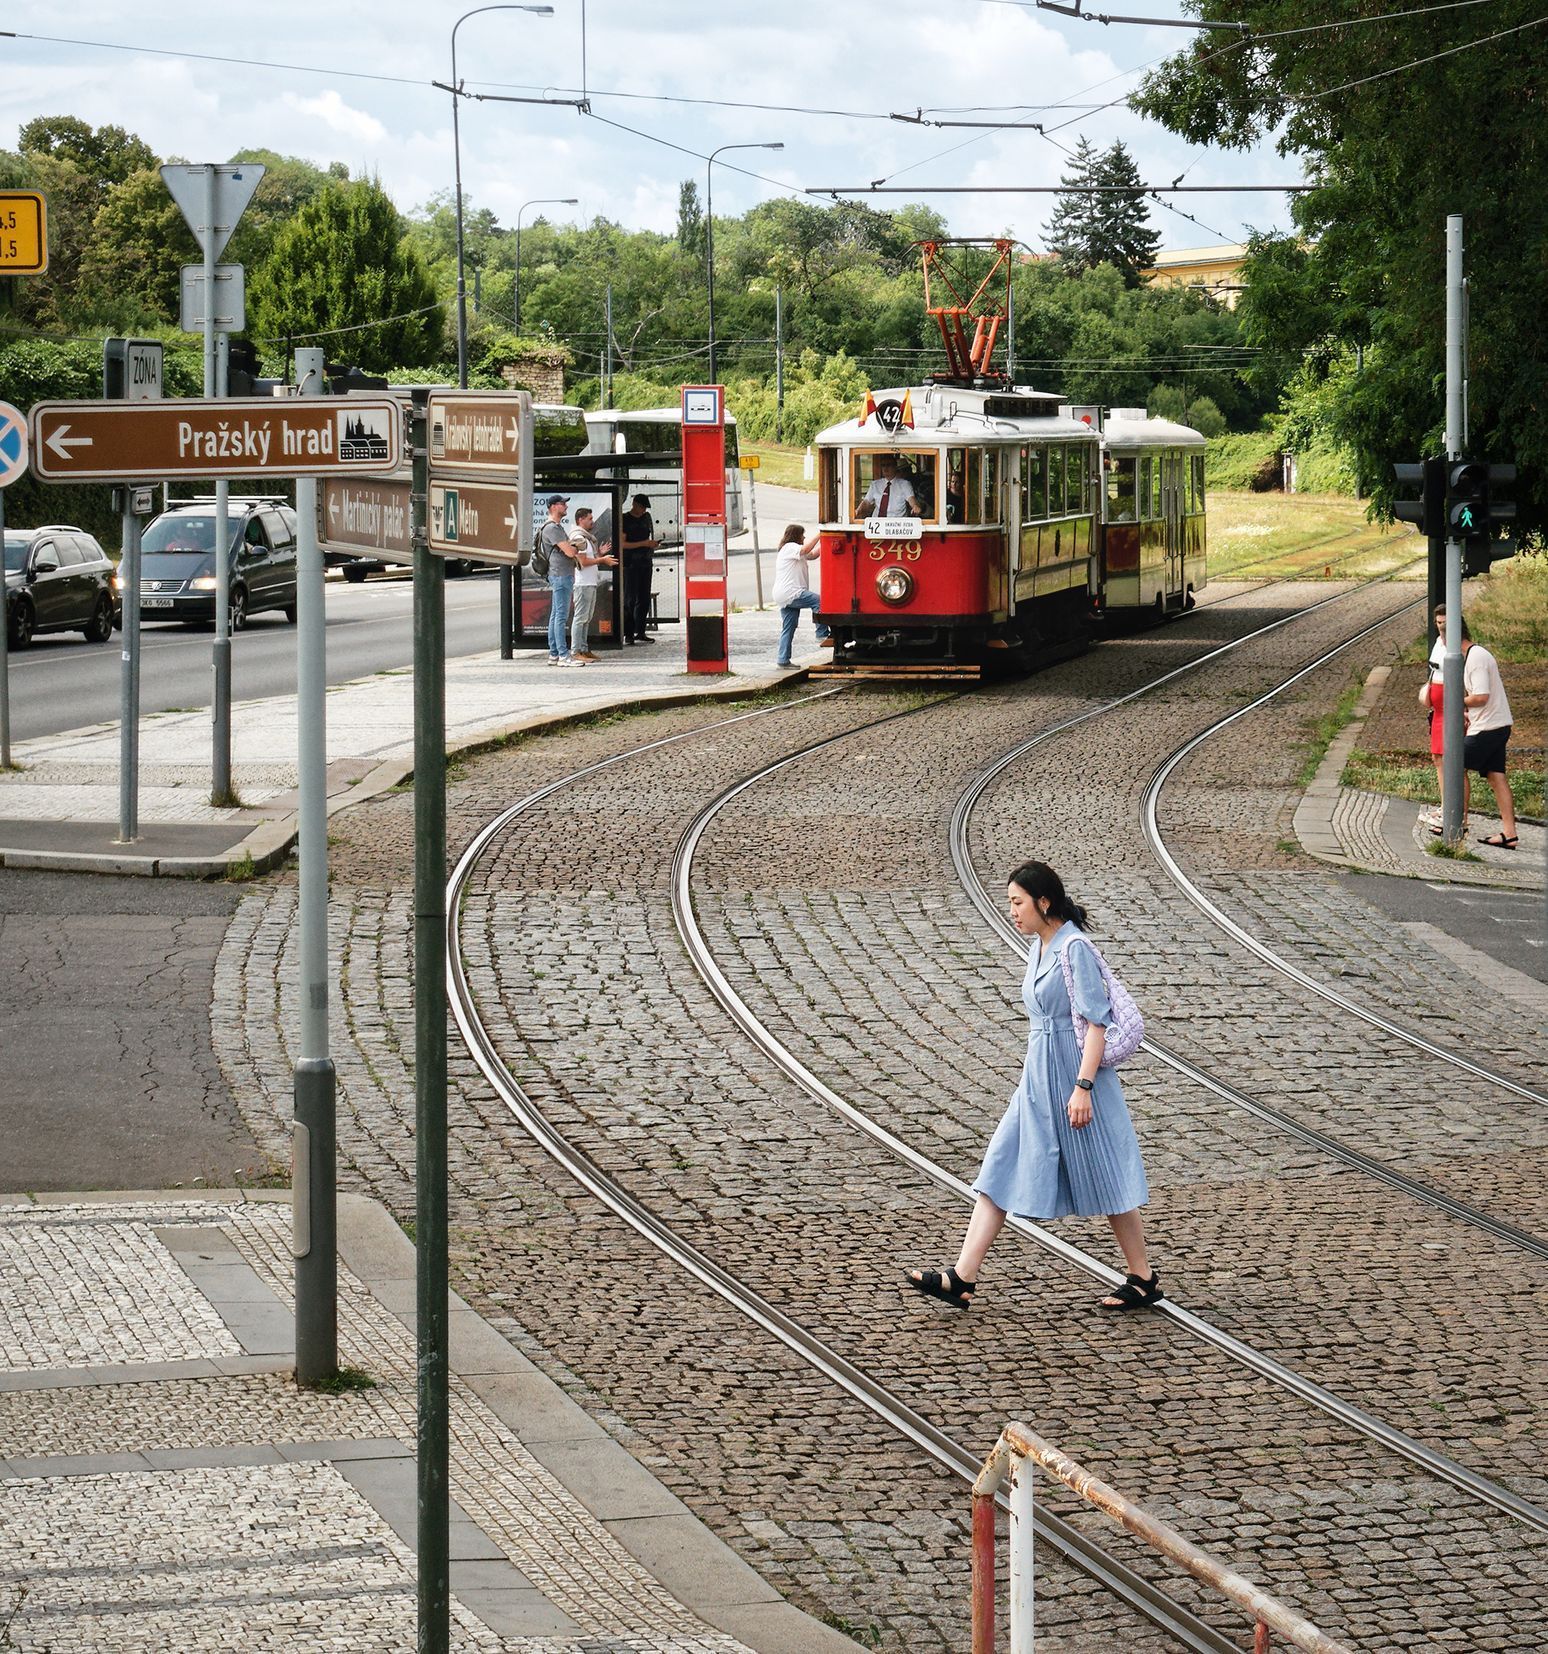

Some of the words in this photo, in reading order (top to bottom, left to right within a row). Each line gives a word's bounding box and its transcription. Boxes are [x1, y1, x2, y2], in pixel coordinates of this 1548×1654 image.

[133, 348, 157, 385] ZÓNA
[883, 406, 901, 423] 42
[178, 420, 271, 466] Pražský
[282, 419, 333, 456] hrad
[342, 489, 381, 548] Martinický
[383, 494, 404, 549] palác
[447, 497, 456, 534] A
[459, 499, 479, 537] Metro
[868, 521, 881, 535] 42
[885, 528, 914, 536] DLABAČOV
[869, 539, 922, 561] 349
